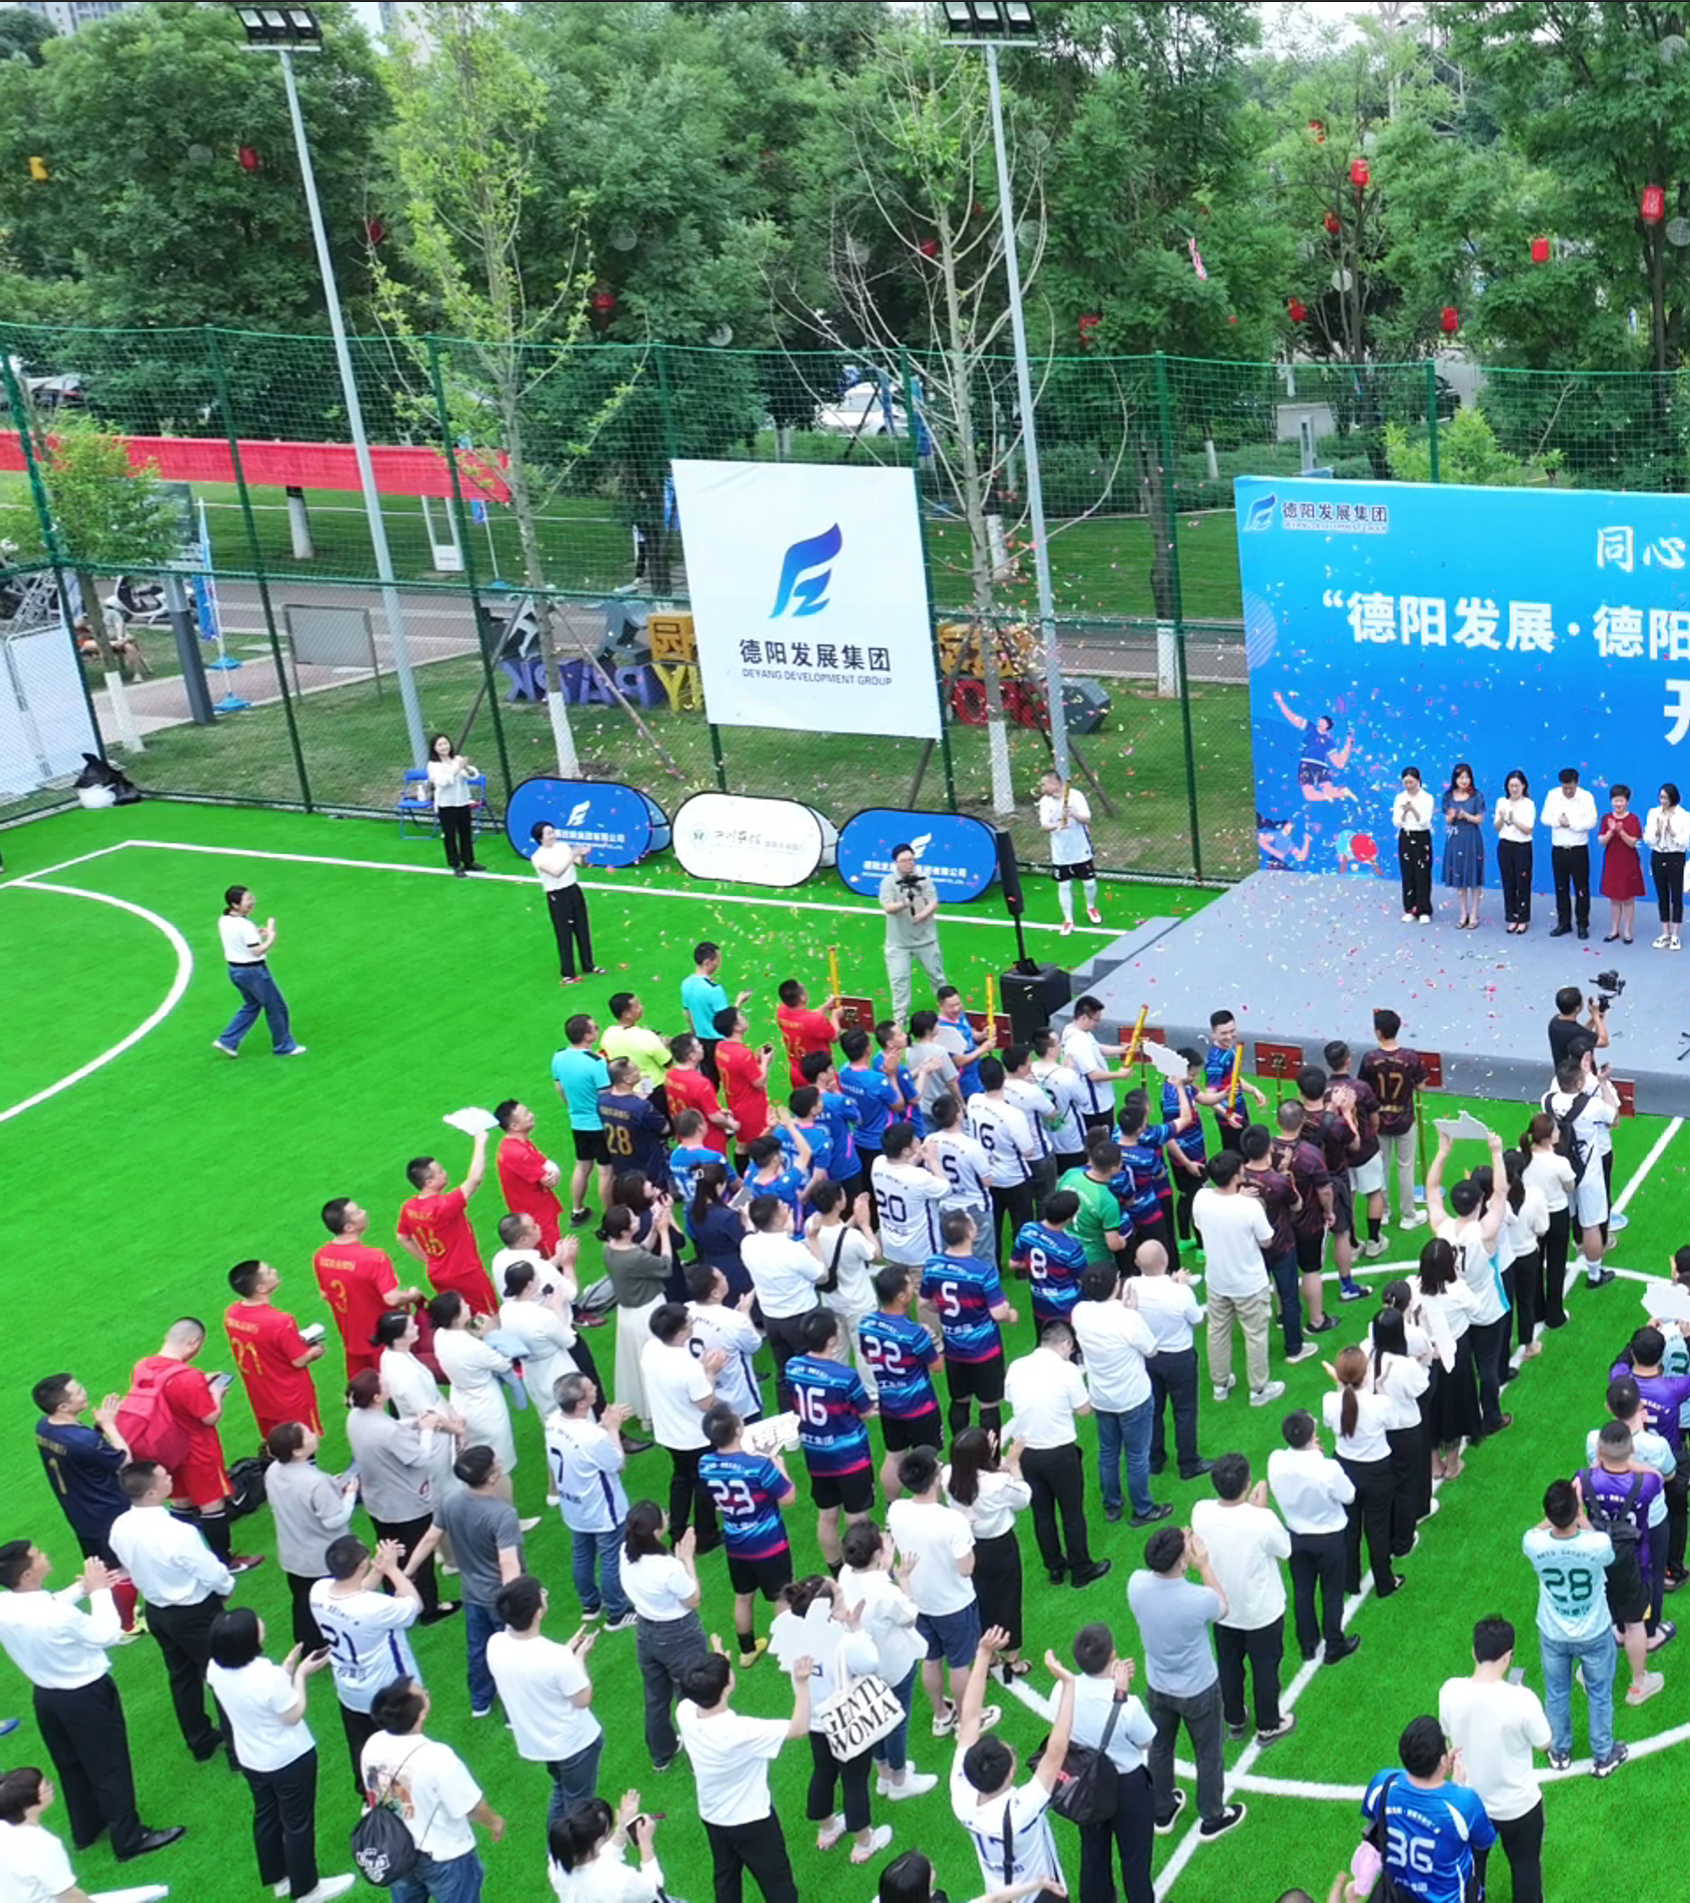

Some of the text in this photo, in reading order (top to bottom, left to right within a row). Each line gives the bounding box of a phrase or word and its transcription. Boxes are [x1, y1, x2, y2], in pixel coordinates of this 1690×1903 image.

[1282, 502, 1387, 522] 德阳发展集团
[739, 639, 891, 672] 德阳发展集团
[742, 668, 892, 686] DEYANG DEVELOPMENT GROUP
[1377, 1071, 1404, 1100] 17
[604, 1122, 634, 1156] 28
[972, 1117, 996, 1151] 16
[942, 1154, 961, 1184] 5
[875, 1188, 908, 1223] 20
[1030, 1247, 1048, 1280] 8
[330, 1279, 348, 1314] 3
[941, 1281, 961, 1318] 5
[864, 1335, 906, 1375] 22
[794, 1383, 829, 1427] 16
[550, 1446, 564, 1485] 7
[707, 1479, 756, 1516] 23
[1541, 1567, 1593, 1603] 28
[320, 1623, 360, 1666] 21
[820, 1677, 889, 1735] GENTL
[831, 1698, 899, 1754] WOMA
[1386, 1826, 1436, 1874] 36
